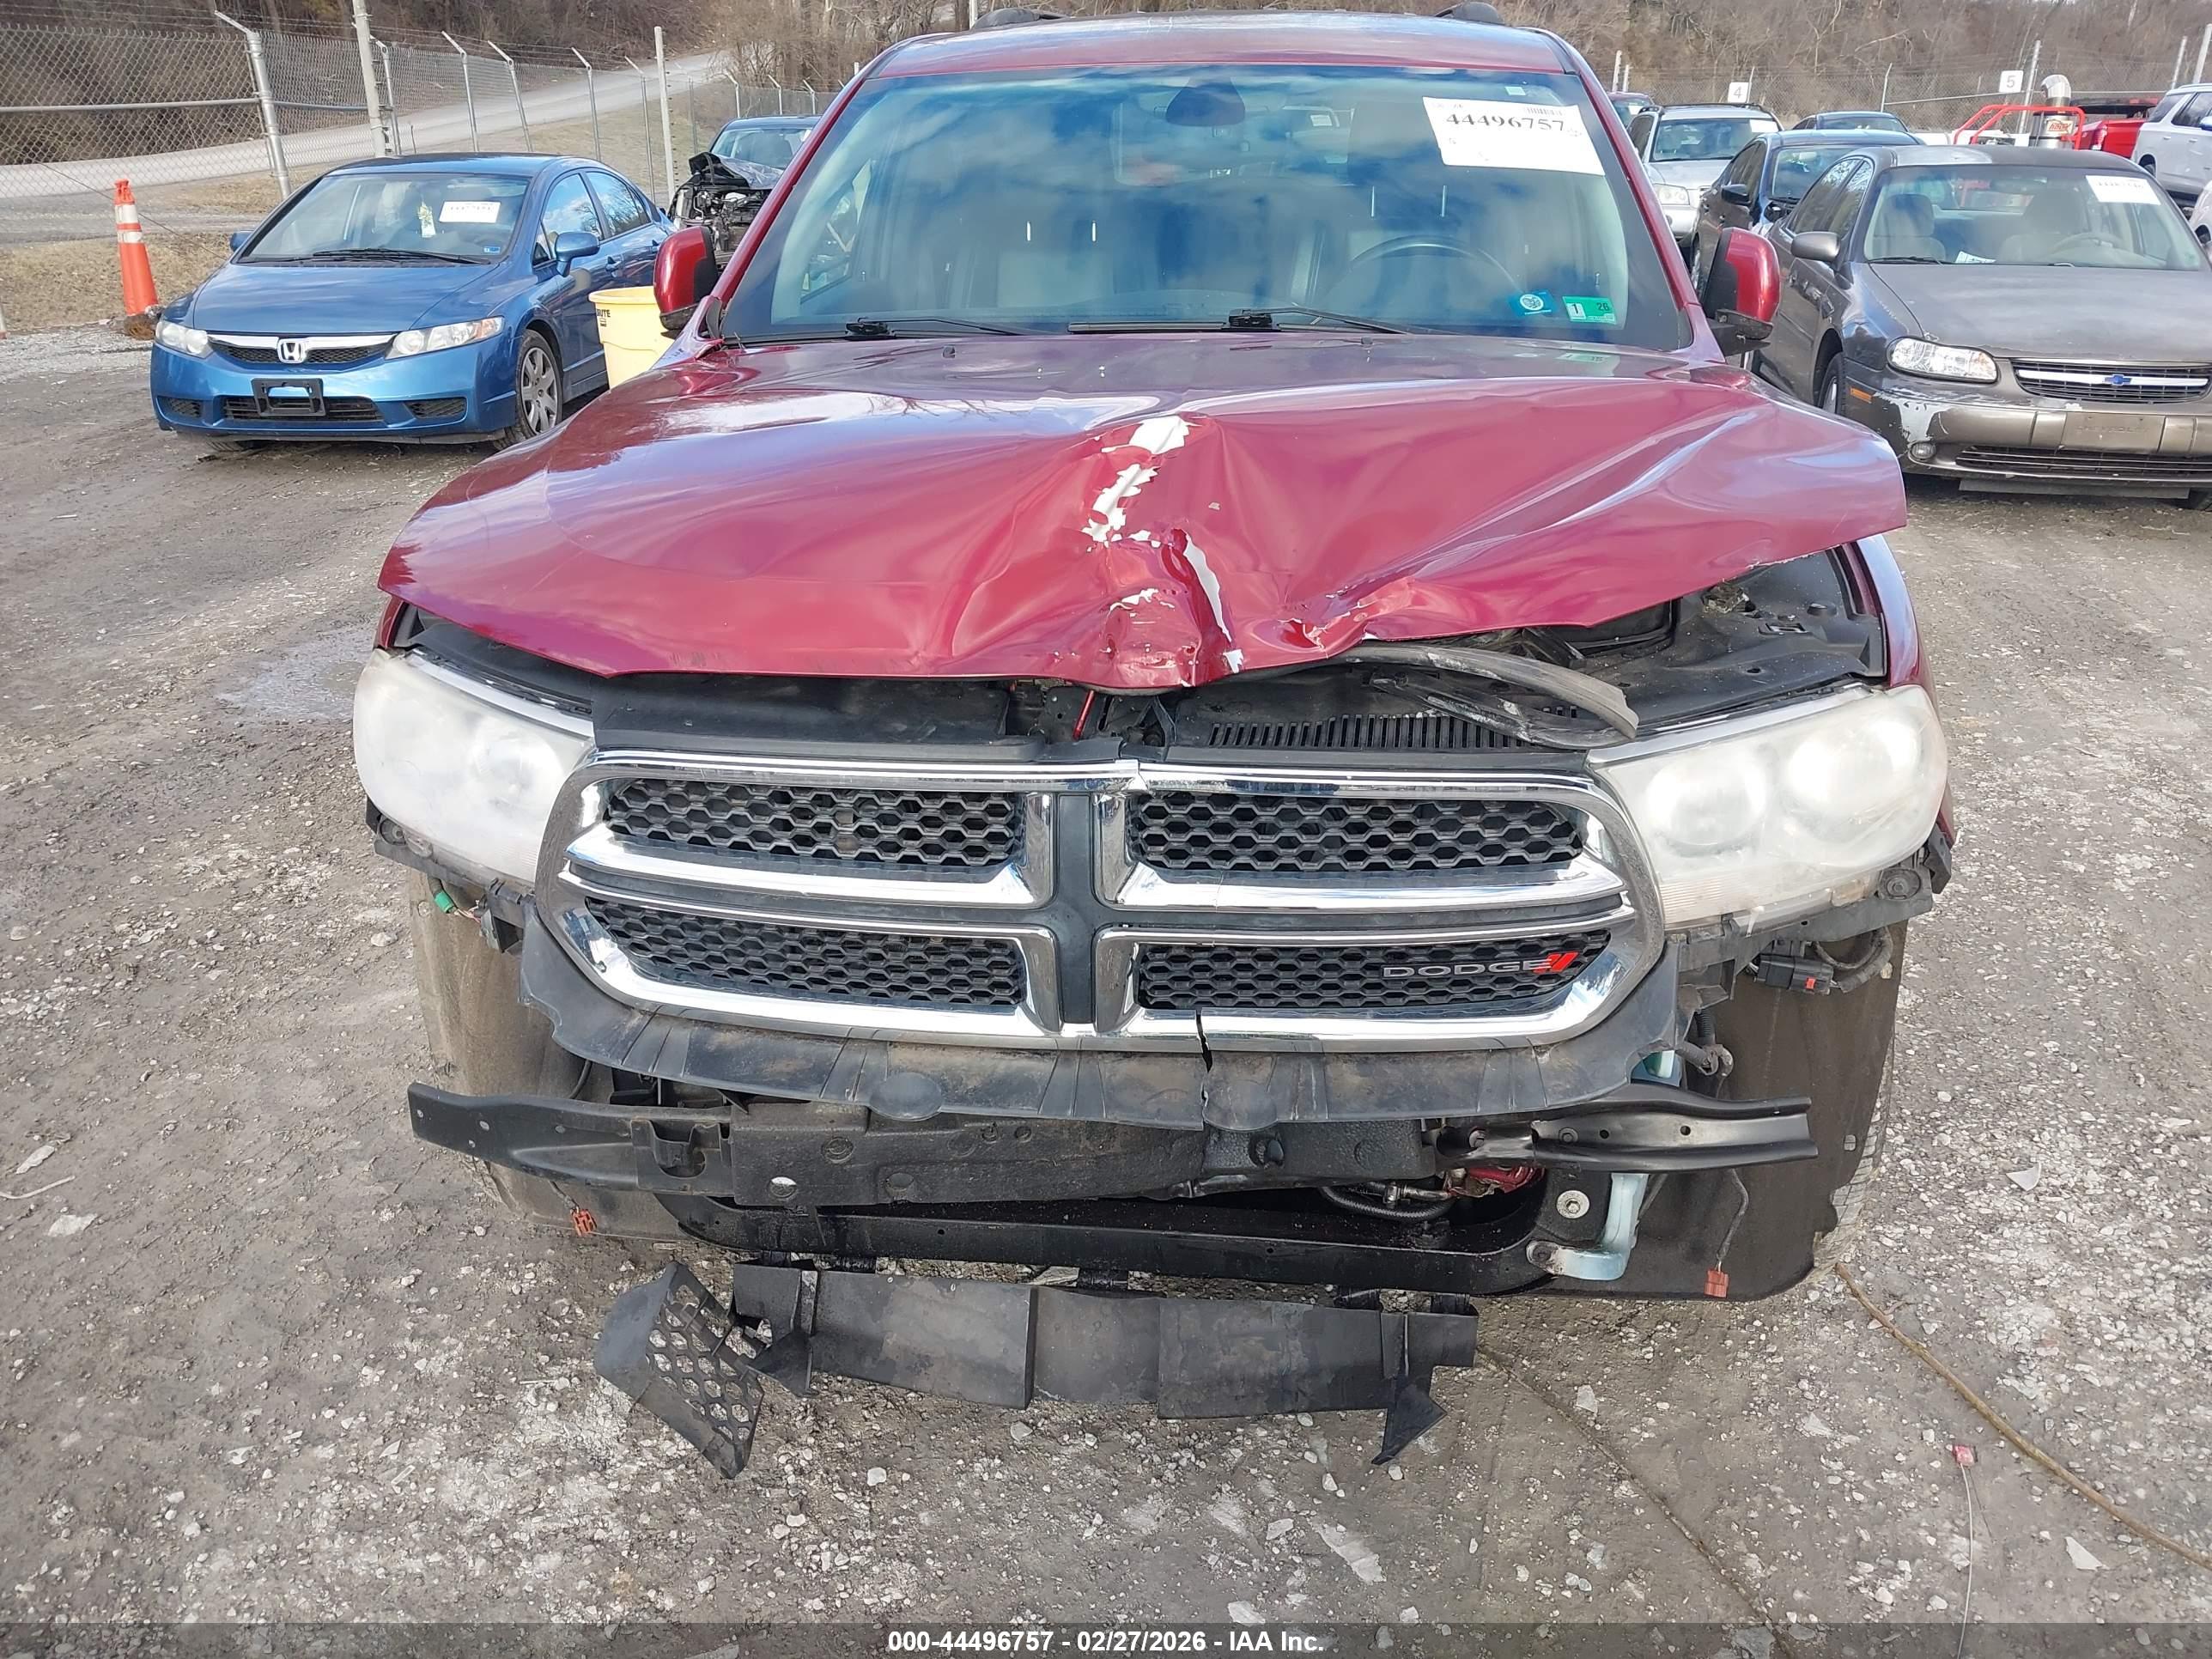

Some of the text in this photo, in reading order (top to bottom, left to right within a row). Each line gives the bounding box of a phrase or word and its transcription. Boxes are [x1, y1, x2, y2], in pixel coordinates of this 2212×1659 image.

[2006, 75, 2016, 88] 5
[1733, 86, 1743, 99] 4
[1446, 112, 1565, 131] 44496757
[1382, 957, 1553, 978] DODGE
